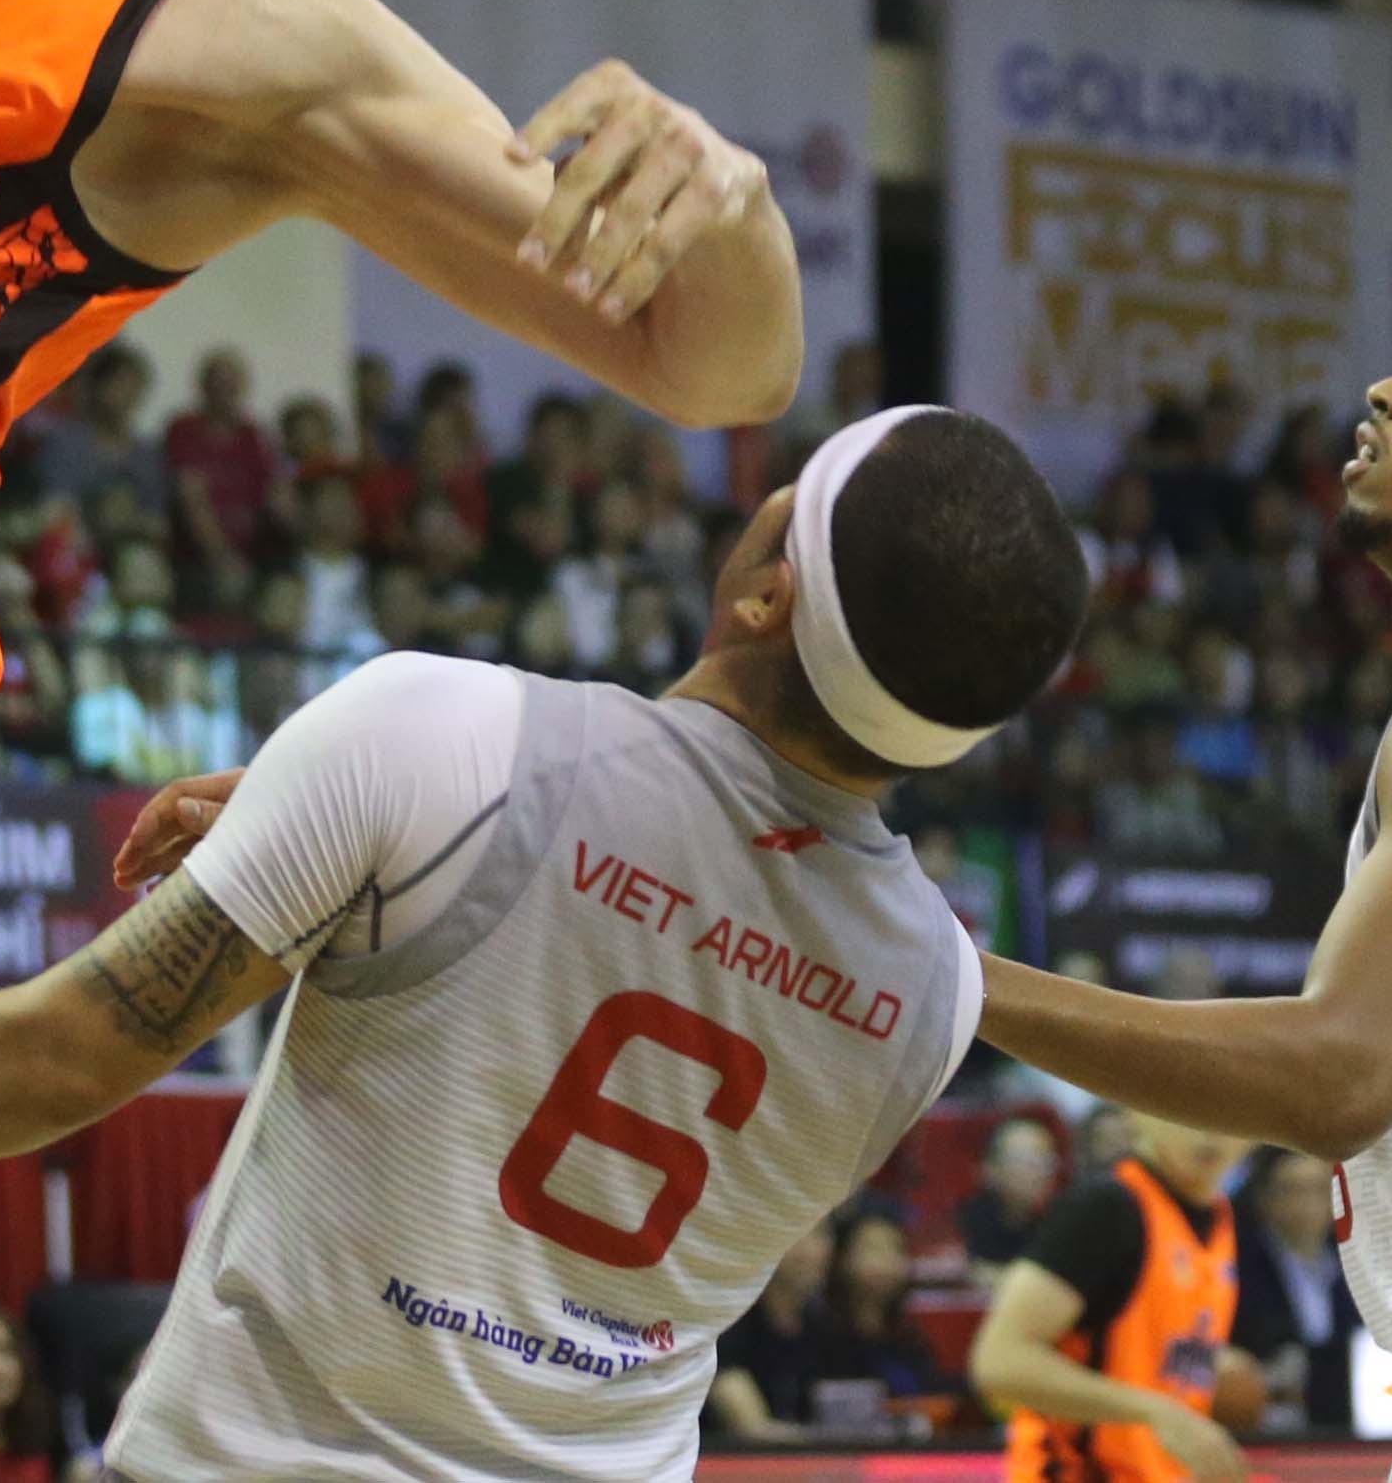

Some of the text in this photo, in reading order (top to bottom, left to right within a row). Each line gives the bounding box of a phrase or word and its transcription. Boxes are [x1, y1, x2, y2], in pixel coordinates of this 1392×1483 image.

[1001, 44, 1357, 163] GOLDSUN
[574, 839, 903, 1040] VIET ARNOLD
[498, 991, 767, 1268] 6
[382, 1277, 467, 1334] Ngân
[471, 1309, 545, 1364] hàng
[547, 1336, 614, 1379] Bản
[562, 1298, 590, 1321] Viet
